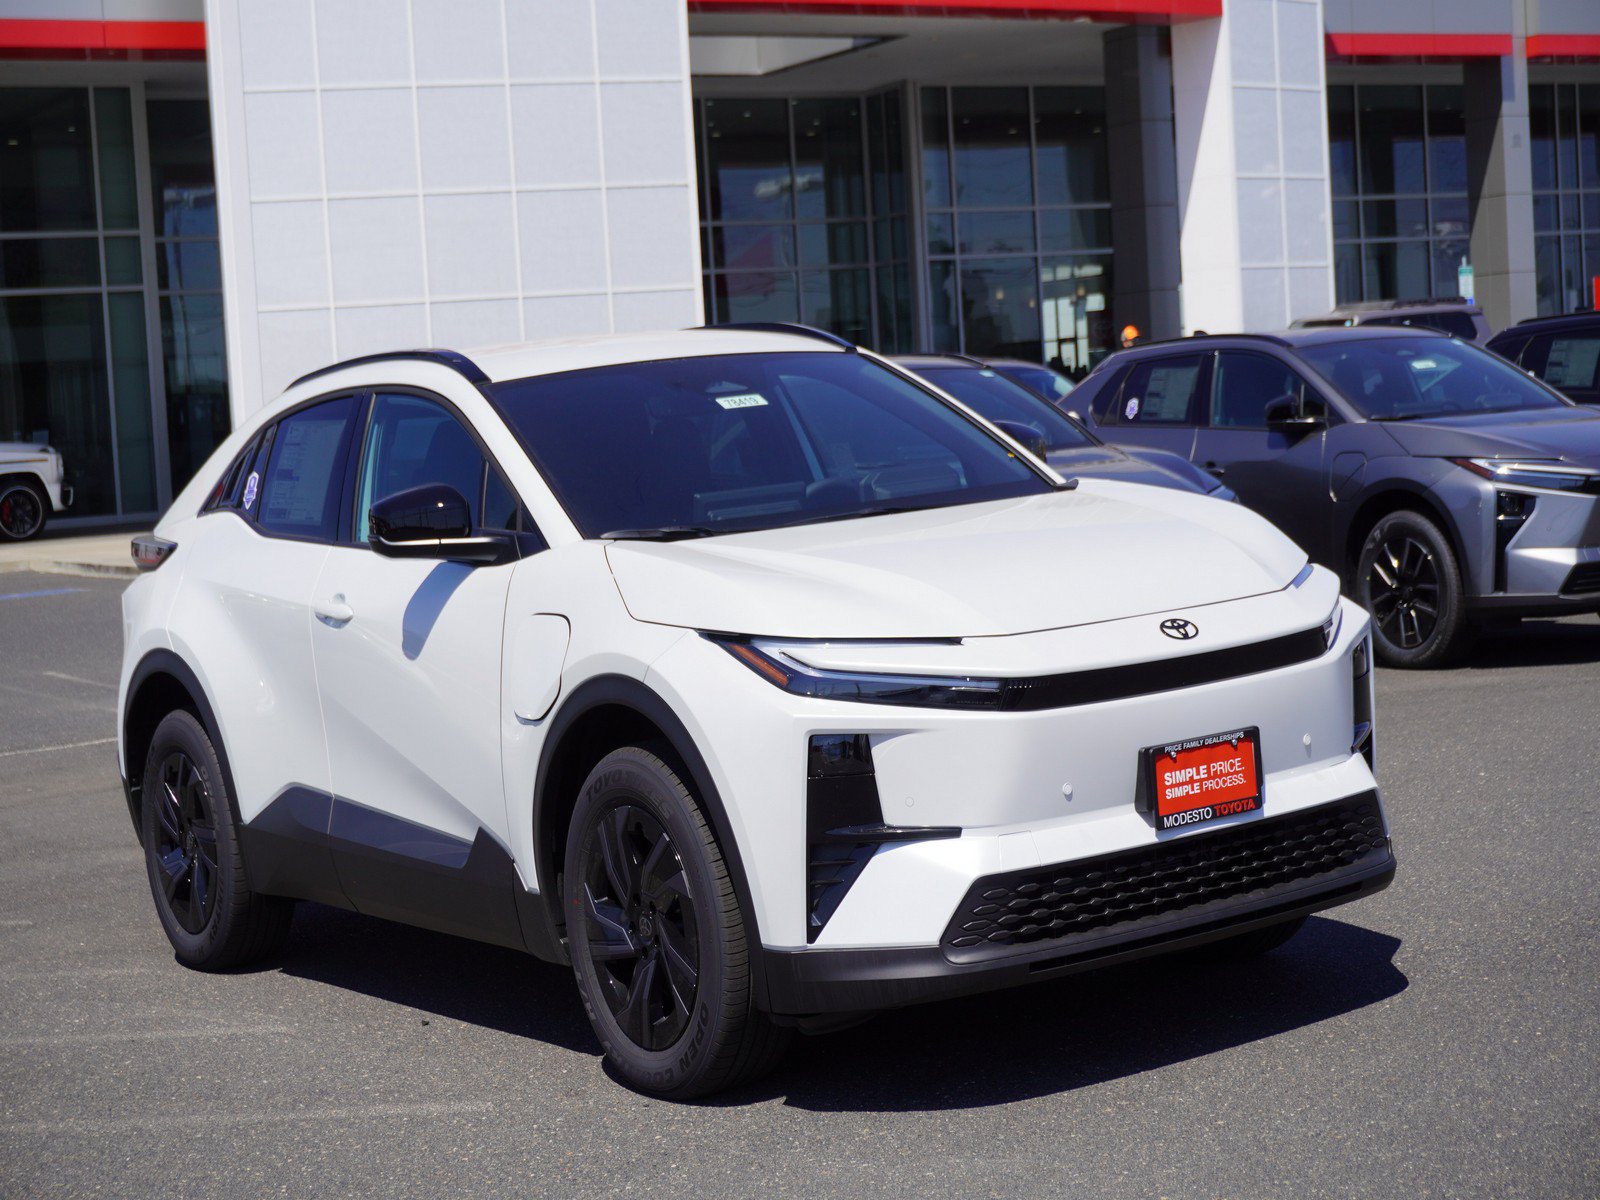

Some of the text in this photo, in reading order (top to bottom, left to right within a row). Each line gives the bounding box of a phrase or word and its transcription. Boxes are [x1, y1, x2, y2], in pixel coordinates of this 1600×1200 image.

[1164, 731, 1245, 753] PRICE FAMILY DEALERSHIPS
[586, 768, 623, 803] TOYO
[1164, 758, 1245, 786] SIMPLE PRICE.
[1165, 773, 1246, 800] SIMPLE PROCESS.
[1163, 798, 1256, 828] MODESTO TOYOTA
[678, 1001, 710, 1073] OPEN
